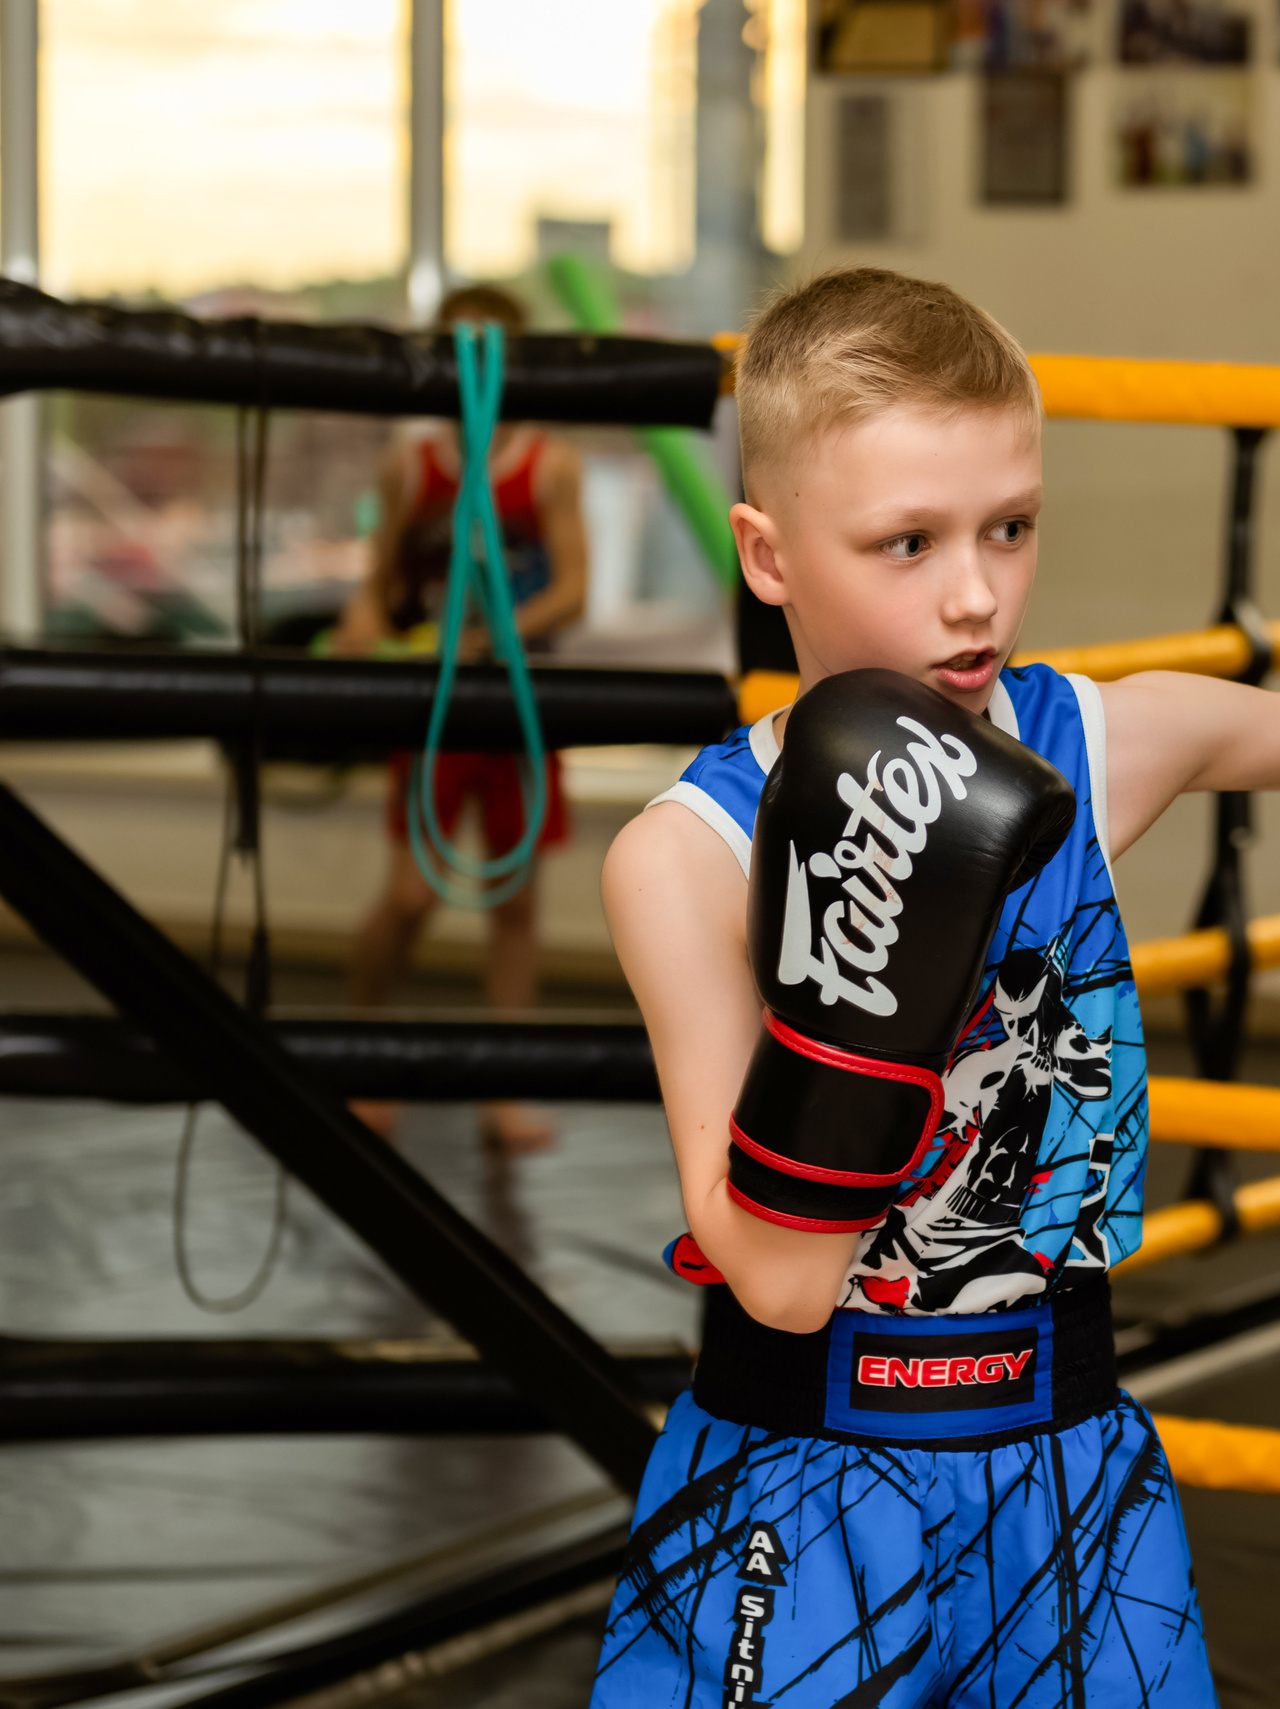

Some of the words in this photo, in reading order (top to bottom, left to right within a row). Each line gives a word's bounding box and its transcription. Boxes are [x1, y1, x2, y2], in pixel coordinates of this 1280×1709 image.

[777, 715, 978, 1017] Fairtex
[857, 1349, 1034, 1388] ENERGY
[746, 1530, 775, 1576] AA
[728, 1594, 765, 1709] Sitni
